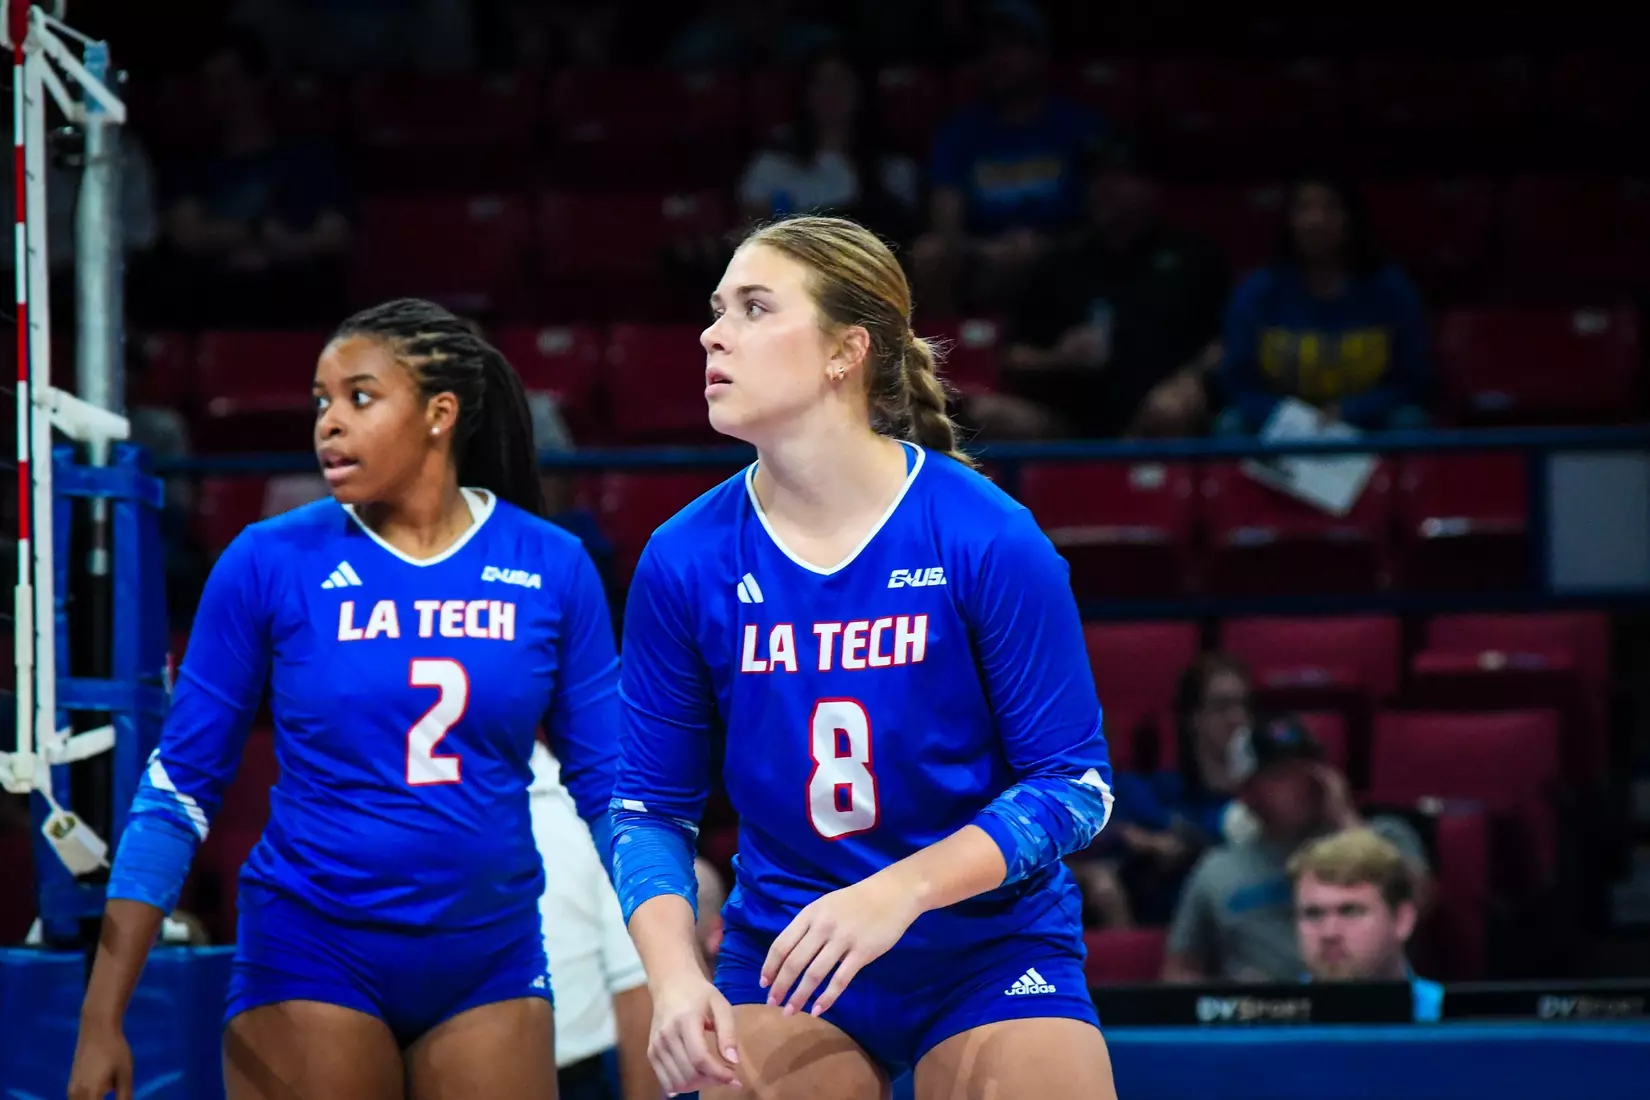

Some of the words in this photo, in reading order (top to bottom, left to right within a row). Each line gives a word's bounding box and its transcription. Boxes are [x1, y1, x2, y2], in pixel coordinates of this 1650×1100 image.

[337, 599, 401, 642] LA
[413, 599, 517, 642] TECH
[740, 622, 799, 673] LA
[812, 614, 929, 672] TECH
[405, 656, 471, 787] 2
[806, 697, 880, 841] 8
[1004, 984, 1057, 996] adidas
